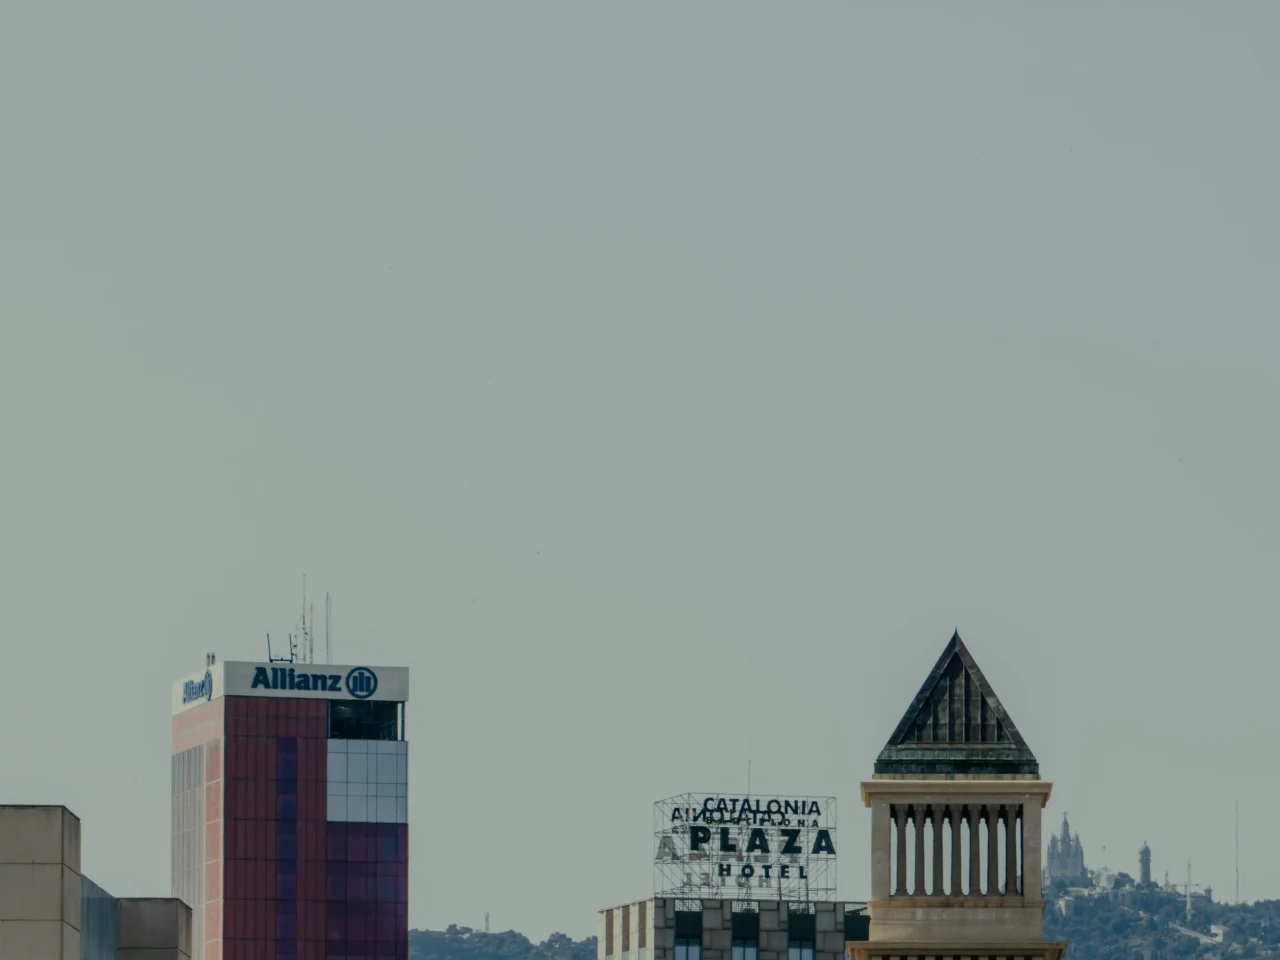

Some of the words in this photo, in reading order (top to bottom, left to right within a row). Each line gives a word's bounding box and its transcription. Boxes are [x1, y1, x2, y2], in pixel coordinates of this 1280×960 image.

[251, 666, 342, 692] Allianz
[703, 797, 821, 816] CATALONIA
[690, 826, 836, 854] PLAZA
[718, 863, 808, 879] HOTEL
